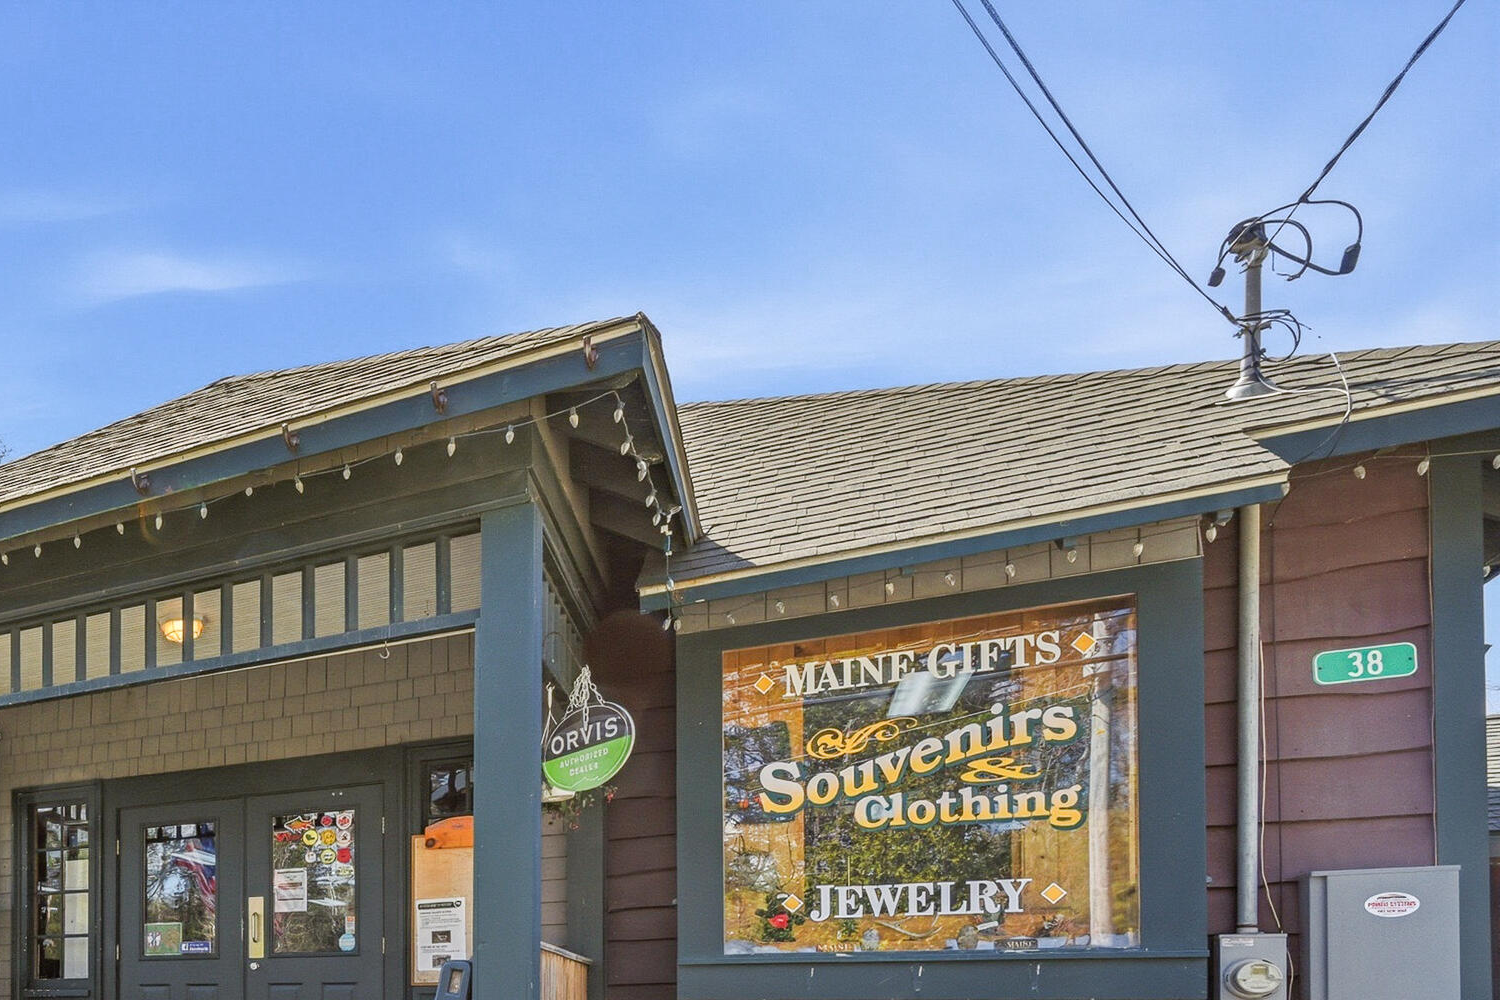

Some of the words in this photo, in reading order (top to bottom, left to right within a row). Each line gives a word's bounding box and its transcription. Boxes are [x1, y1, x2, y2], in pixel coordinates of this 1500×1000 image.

[782, 652, 917, 699] MAINE
[927, 629, 1062, 679] GIFTS
[1347, 650, 1384, 678] 38
[551, 716, 619, 755] ORVIS
[560, 747, 609, 769] AUTHORIZED
[758, 701, 1081, 815] Souvenirs
[960, 757, 1041, 784] &
[853, 782, 1083, 829] Clothing
[809, 878, 1032, 923] JEWELRY
